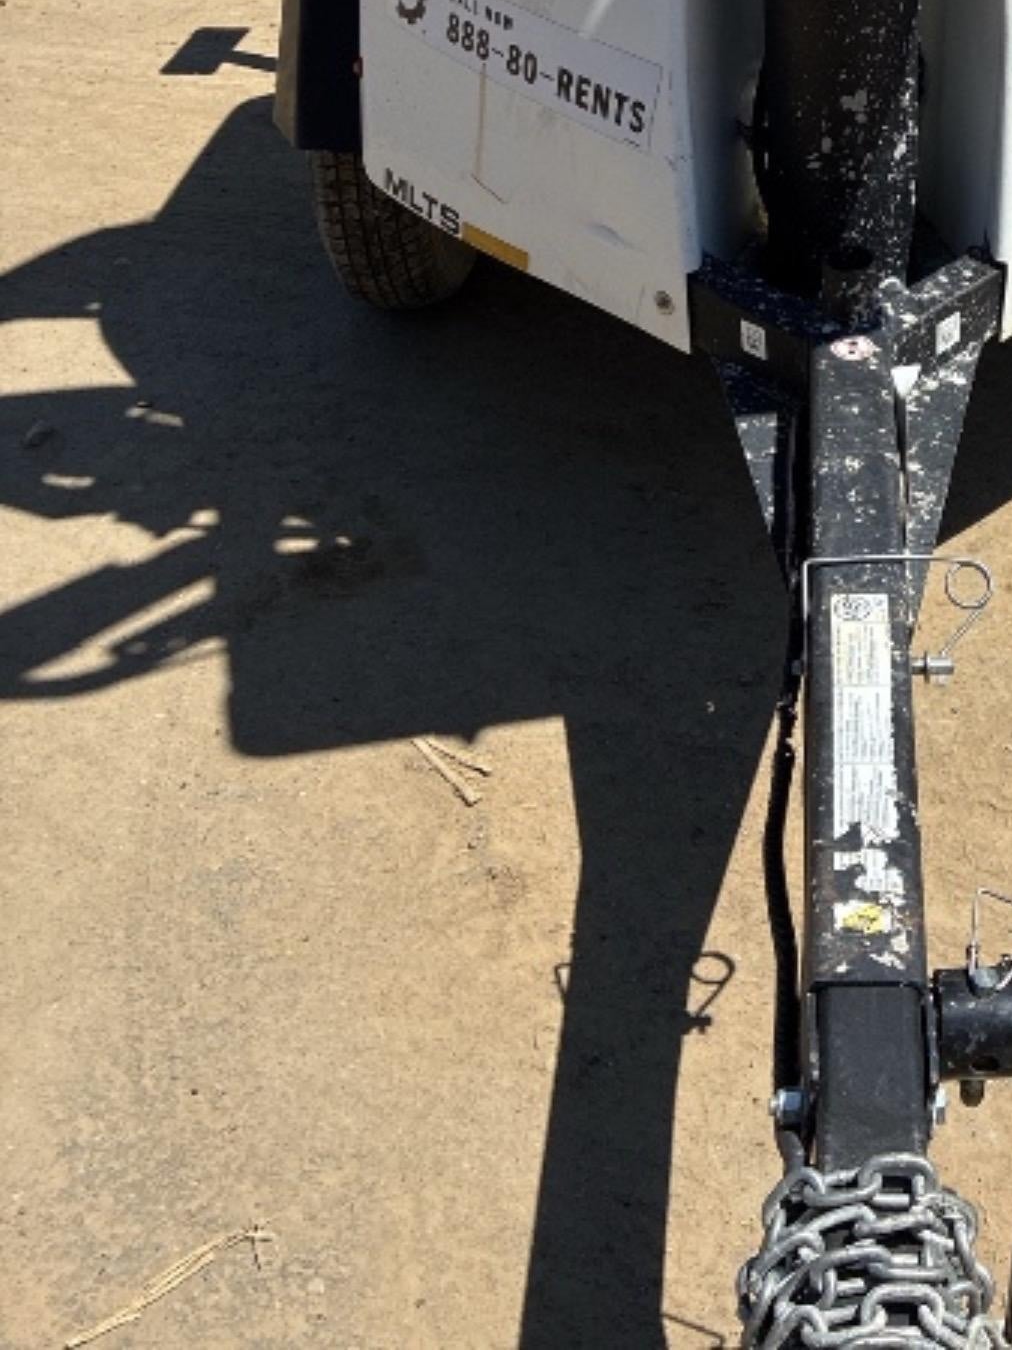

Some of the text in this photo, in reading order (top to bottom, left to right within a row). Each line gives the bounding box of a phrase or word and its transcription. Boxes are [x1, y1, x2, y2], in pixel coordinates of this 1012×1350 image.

[485, 4, 514, 30] NOW
[446, 11, 647, 134] 888-80-RENTS
[384, 168, 460, 234] MLTS
